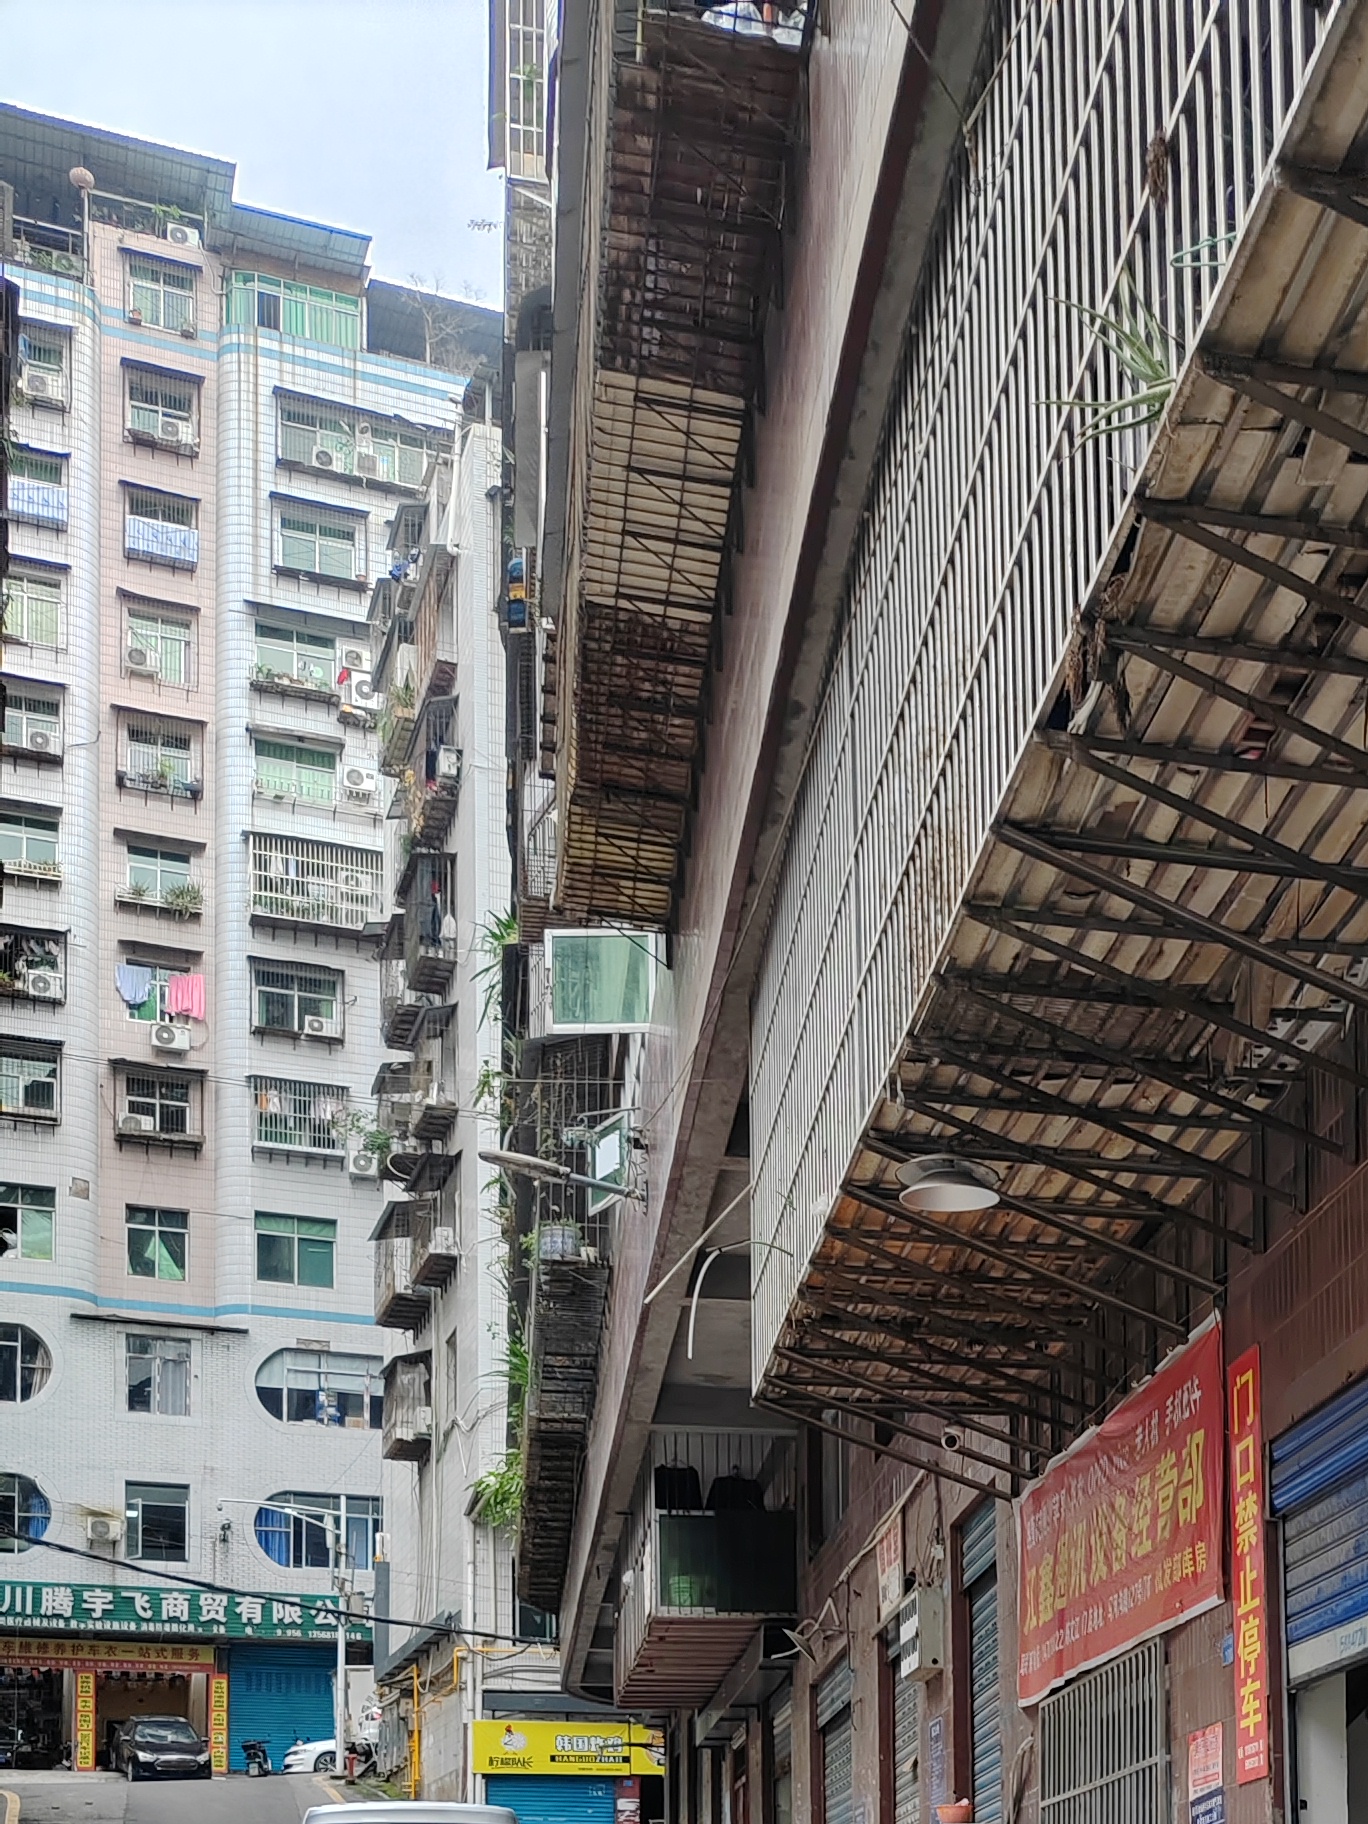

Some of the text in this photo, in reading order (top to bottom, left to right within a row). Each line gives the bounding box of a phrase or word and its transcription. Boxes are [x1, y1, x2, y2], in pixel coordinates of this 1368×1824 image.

[1234, 1368, 1262, 1738] 门口禁止停车
[556, 1735, 623, 1753] 韩国炸鸡
